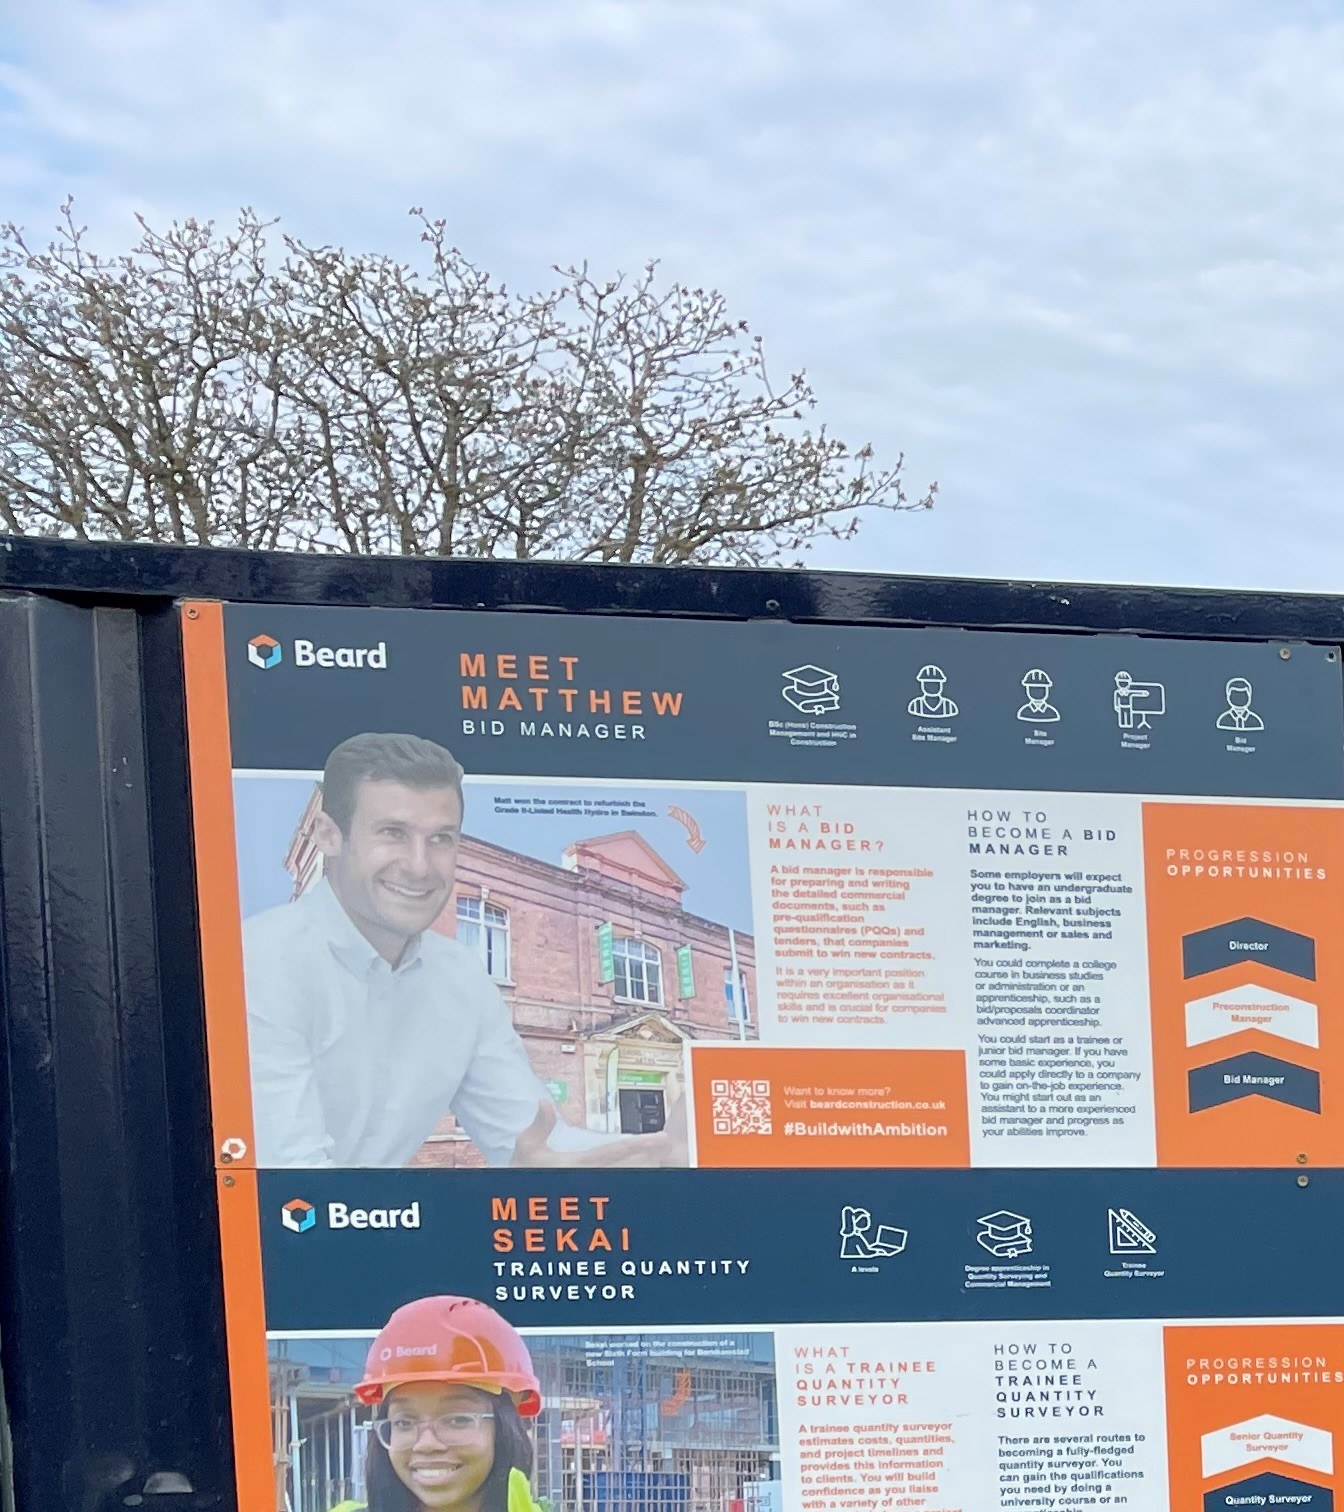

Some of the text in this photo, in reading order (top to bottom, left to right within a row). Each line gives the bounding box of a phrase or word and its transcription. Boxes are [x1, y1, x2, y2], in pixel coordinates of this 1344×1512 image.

[295, 640, 387, 668] Beard
[460, 653, 578, 680] MEET
[462, 686, 682, 716] MATTHEW
[463, 720, 645, 739] BID MANAGER
[767, 805, 822, 817] WHAT
[968, 810, 1047, 823] HOW TO
[769, 821, 854, 834] IS A BID
[968, 826, 1116, 841] BECOME A BID
[769, 838, 883, 851] MANAGER?
[969, 843, 1067, 856] MANAGER
[970, 869, 1122, 883] Some employers will expect
[1223, 1075, 1284, 1086] Bid Manager
[785, 1099, 945, 1109] Visit beardconstruction.co.uk
[784, 1122, 947, 1136] #BuildwithAmbition
[492, 1197, 609, 1221] MEET
[329, 1202, 420, 1230] Beard
[494, 1228, 629, 1252] SEKAI
[494, 1260, 749, 1276] TRAINEE QUANTITY
[496, 1285, 634, 1300] SURVEYOR
[396, 1344, 437, 1357] Beard
[795, 1346, 849, 1358] WHAT
[796, 1361, 935, 1374] IS A TRAINEE
[1187, 1357, 1326, 1369] PROGRESSION
[797, 1378, 899, 1390] QUANTITY
[1187, 1371, 1343, 1385] OPPORTUNITIES
[798, 1394, 908, 1406] SURVEYOR
[998, 1436, 1030, 1445] There
[1053, 1434, 1093, 1443] several
[1097, 1434, 1131, 1442] routes
[1134, 1433, 1145, 1441] to
[1226, 1494, 1312, 1506] Quantity Surveyor
